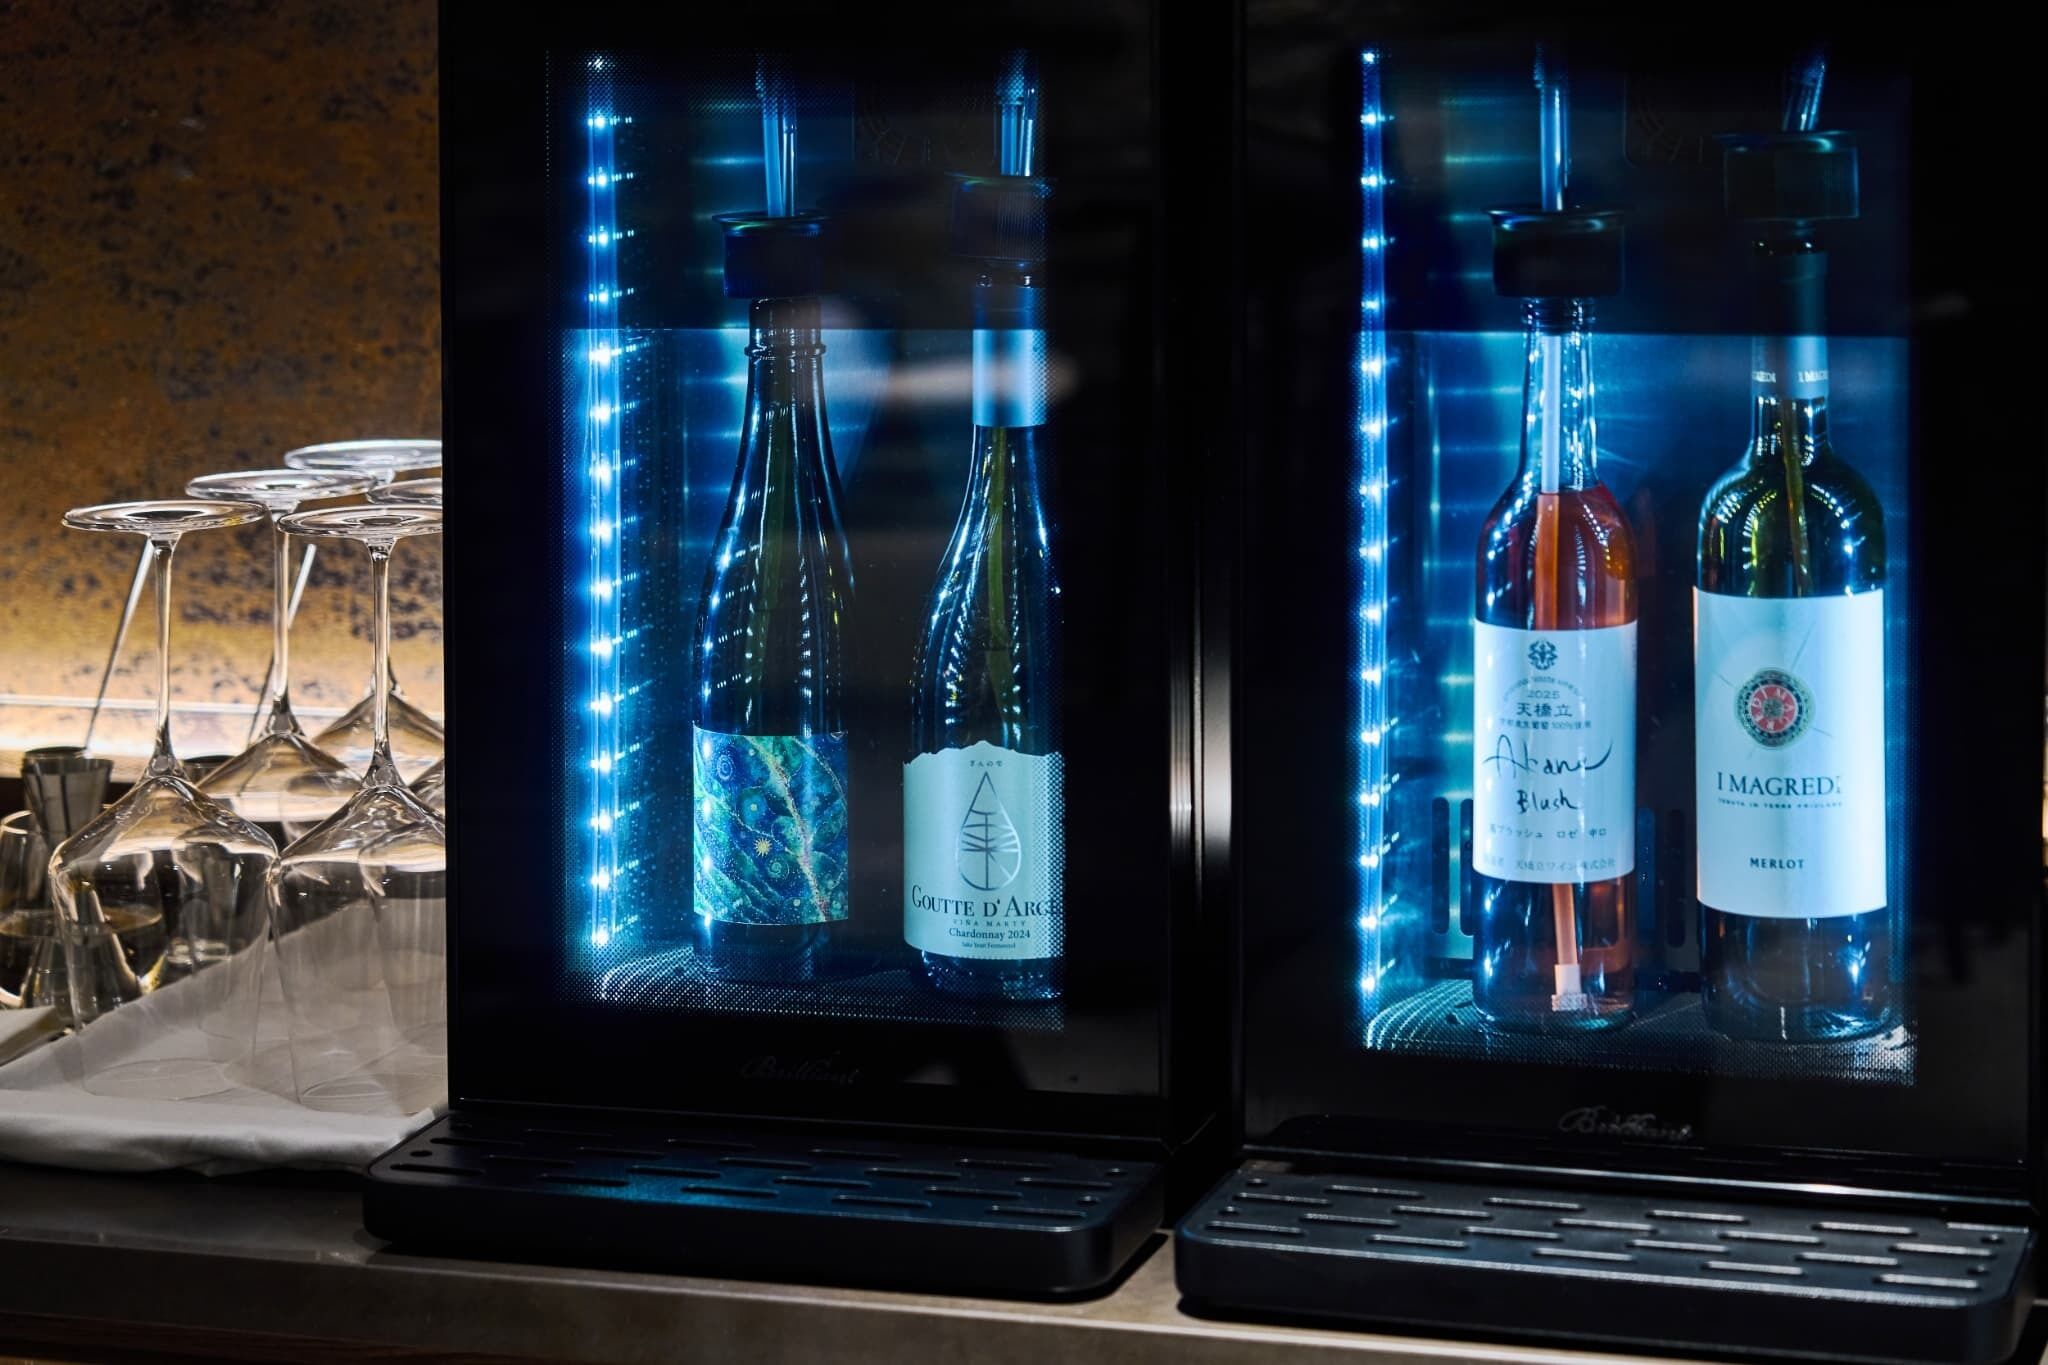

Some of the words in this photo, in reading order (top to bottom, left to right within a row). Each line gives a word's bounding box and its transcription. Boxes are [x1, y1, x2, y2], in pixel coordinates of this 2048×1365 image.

[1516, 702, 1573, 717] 天橋立
[1517, 788, 1580, 815] Blush
[1749, 857, 1805, 870] MERLOT
[949, 927, 1006, 942] Chardonnay
[1007, 929, 1030, 940] 2024
